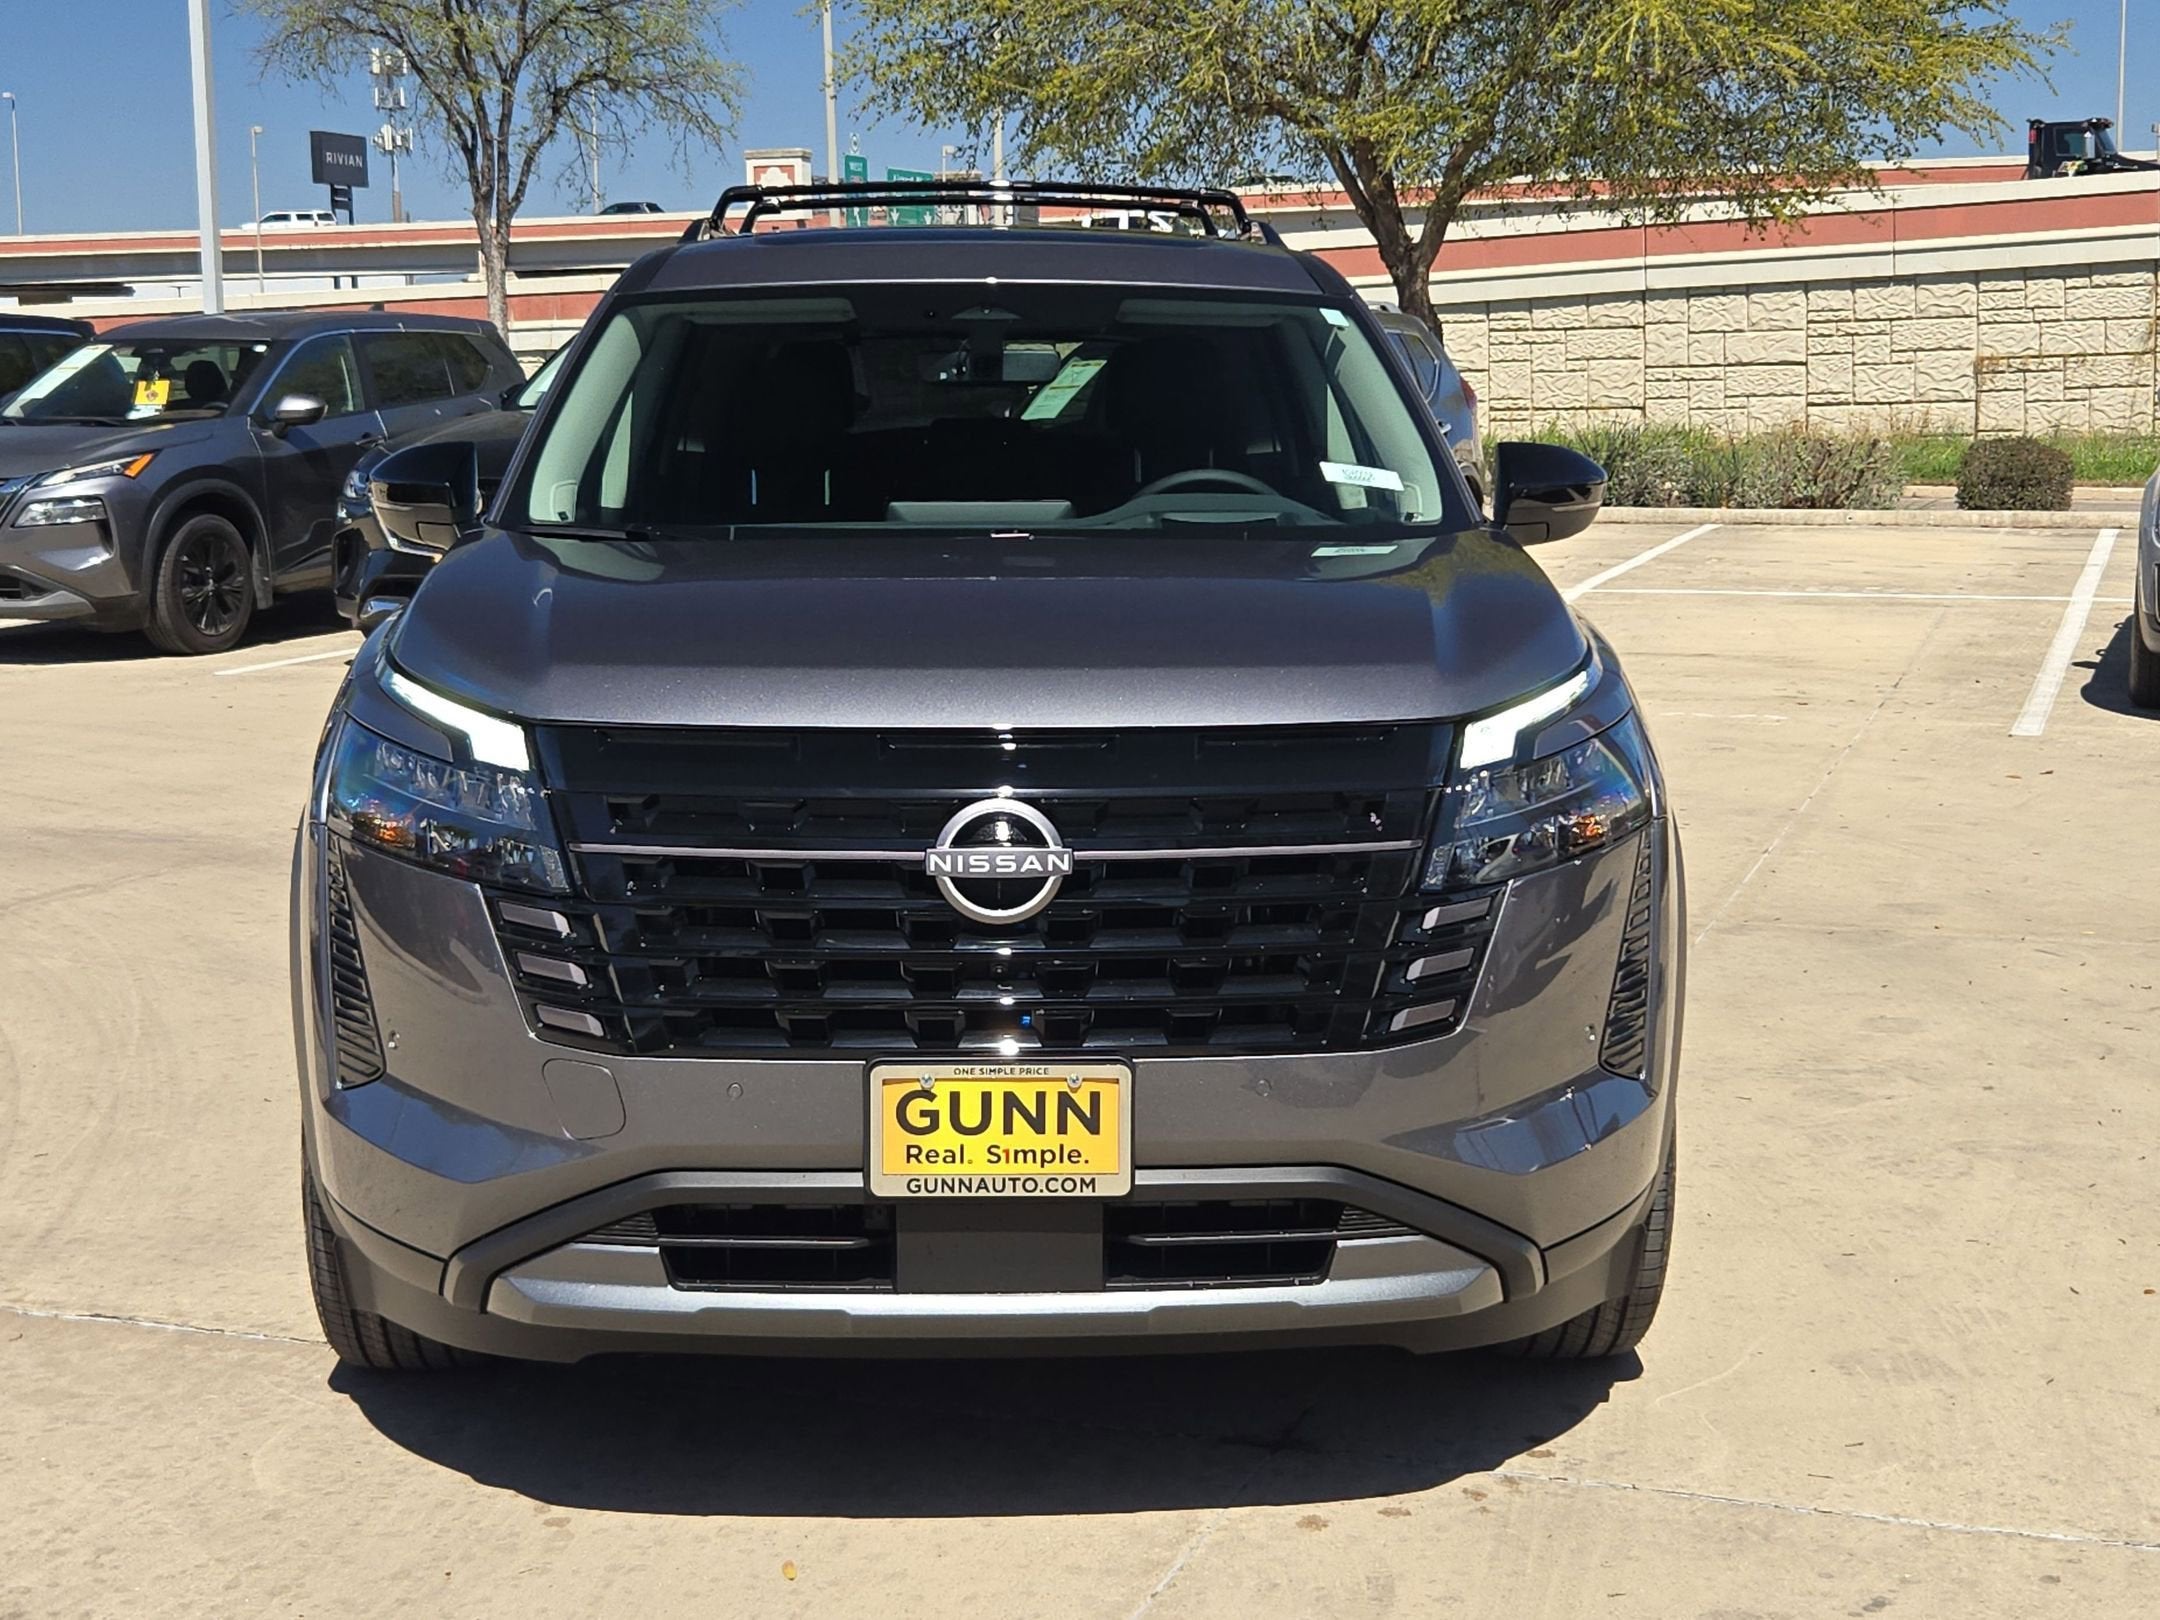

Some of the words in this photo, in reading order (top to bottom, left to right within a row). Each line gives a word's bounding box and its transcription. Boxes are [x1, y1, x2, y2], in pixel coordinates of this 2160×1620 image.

[326, 151, 363, 168] RIVIAN
[929, 853, 1070, 873] NISSAN
[953, 1067, 976, 1076] ONE
[979, 1067, 1016, 1076] SIMPLE
[1019, 1067, 1050, 1076] PRICE
[896, 1089, 1101, 1136] GUNN
[906, 1144, 974, 1165] Real.
[906, 1177, 1097, 1194] GUNNAUTO.COM
